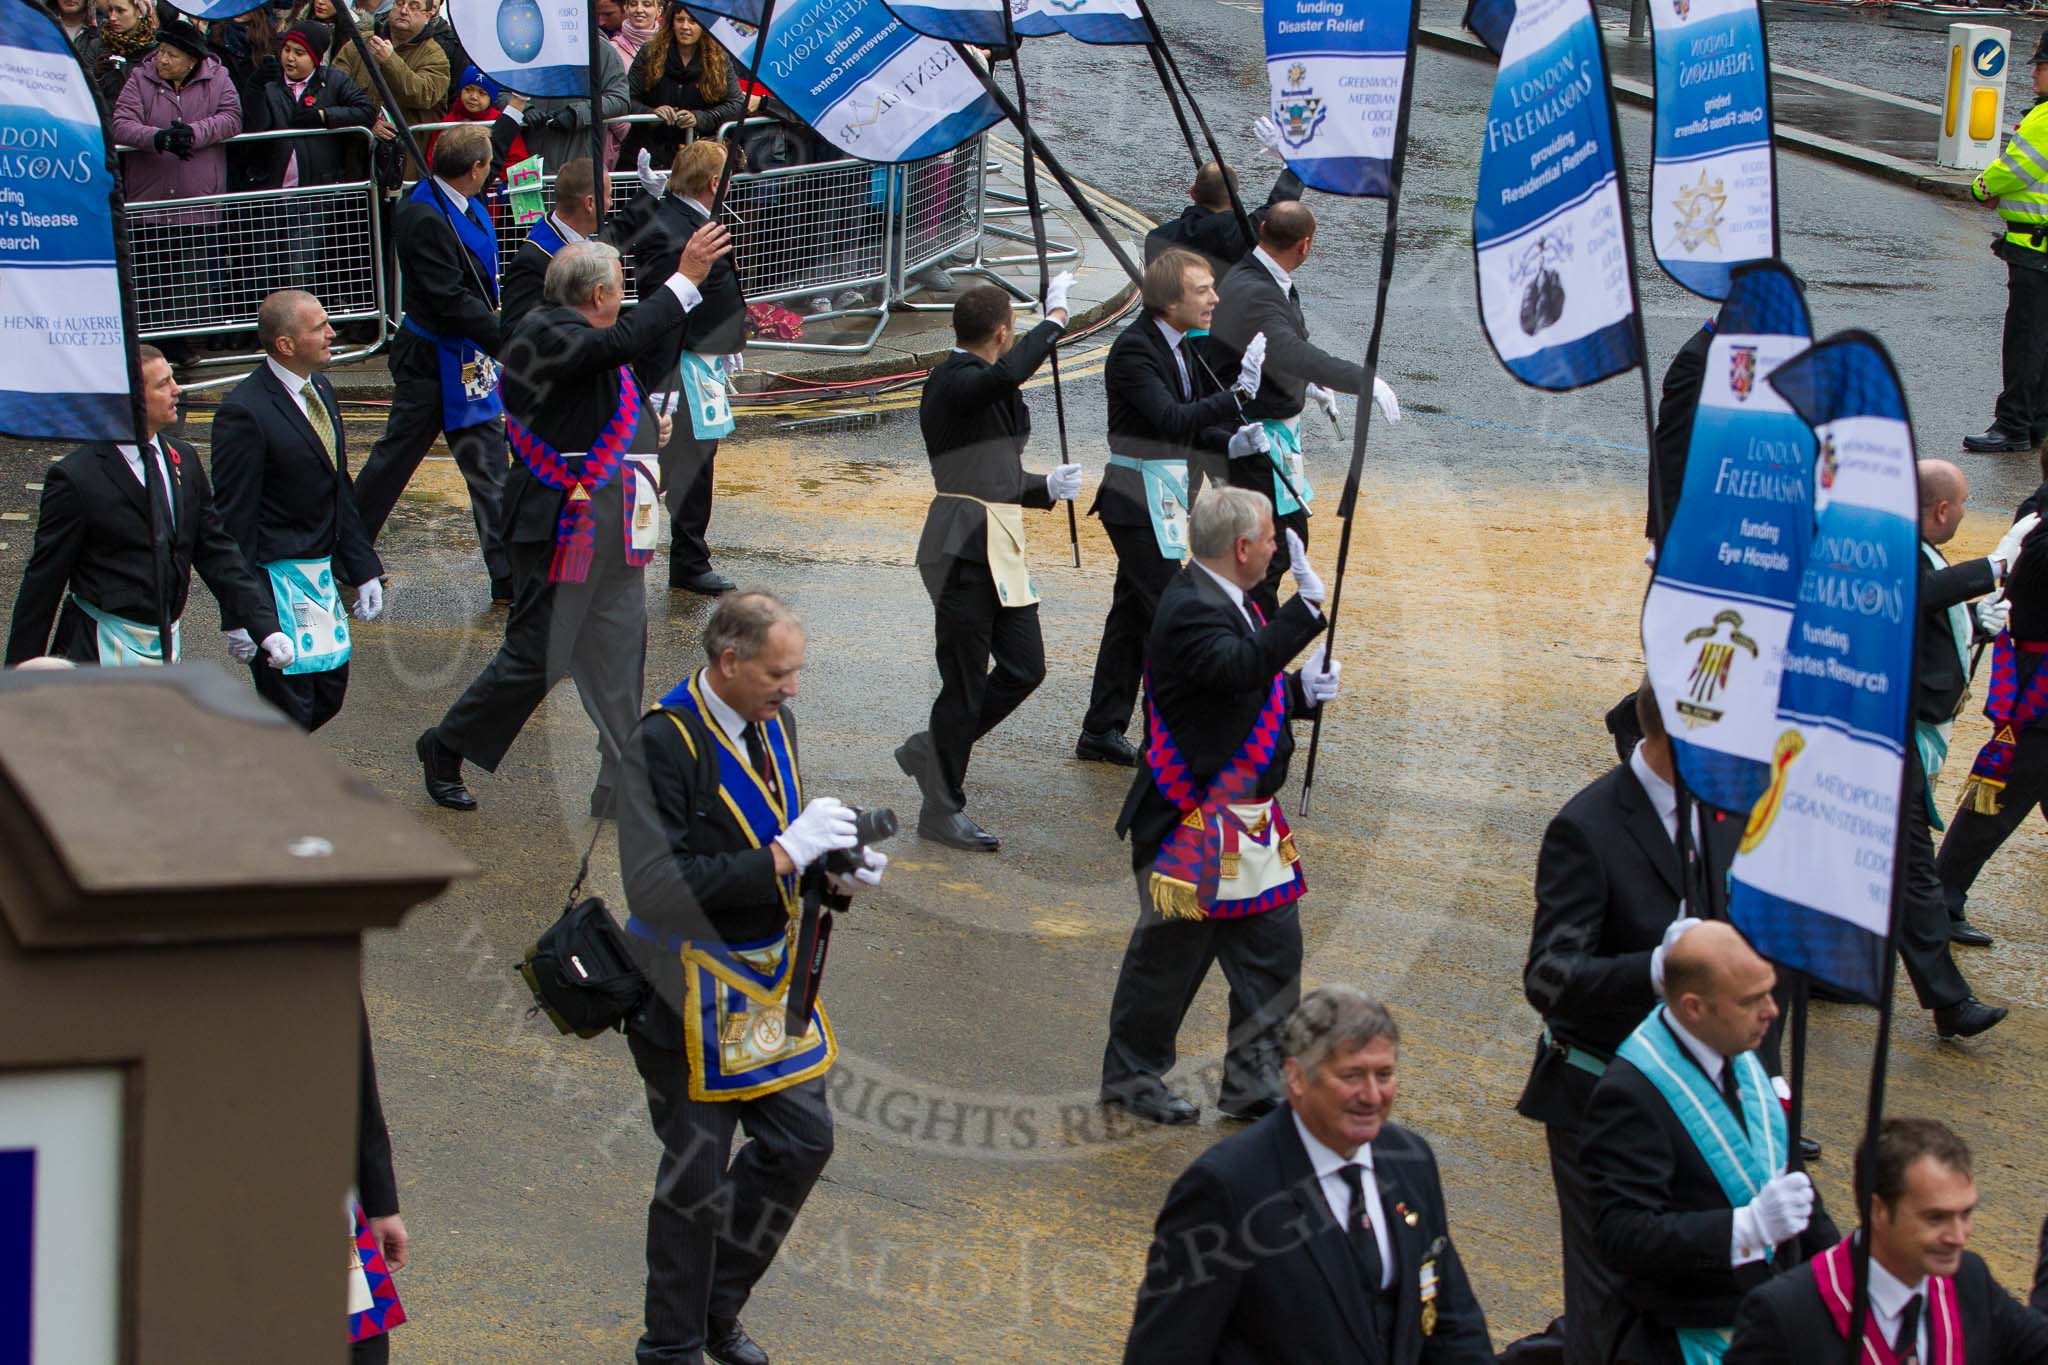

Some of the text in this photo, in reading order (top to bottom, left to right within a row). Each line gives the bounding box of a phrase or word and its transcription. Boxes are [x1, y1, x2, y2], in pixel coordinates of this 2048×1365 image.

[1296, 1, 1344, 15] funding
[1278, 19, 1365, 34] Disaster Relief
[1338, 75, 1399, 89] GREENWICH
[1510, 51, 1575, 108] LONDON
[1488, 60, 1593, 152] FREEMASONS
[1, 127, 58, 149] DON
[1530, 130, 1577, 170] providing
[1501, 161, 1562, 206] Residential
[0, 187, 25, 207] ding
[21, 211, 79, 228] Disease
[0, 234, 40, 250] earch
[4, 316, 50, 330] HENRY
[65, 316, 120, 331] AUXERRE
[48, 331, 121, 346] LODGE 7235
[1718, 542, 1743, 566] Eye
[1809, 535, 1889, 570] ONDON
[1803, 620, 1850, 656] funding
[1827, 656, 1891, 697] Research
